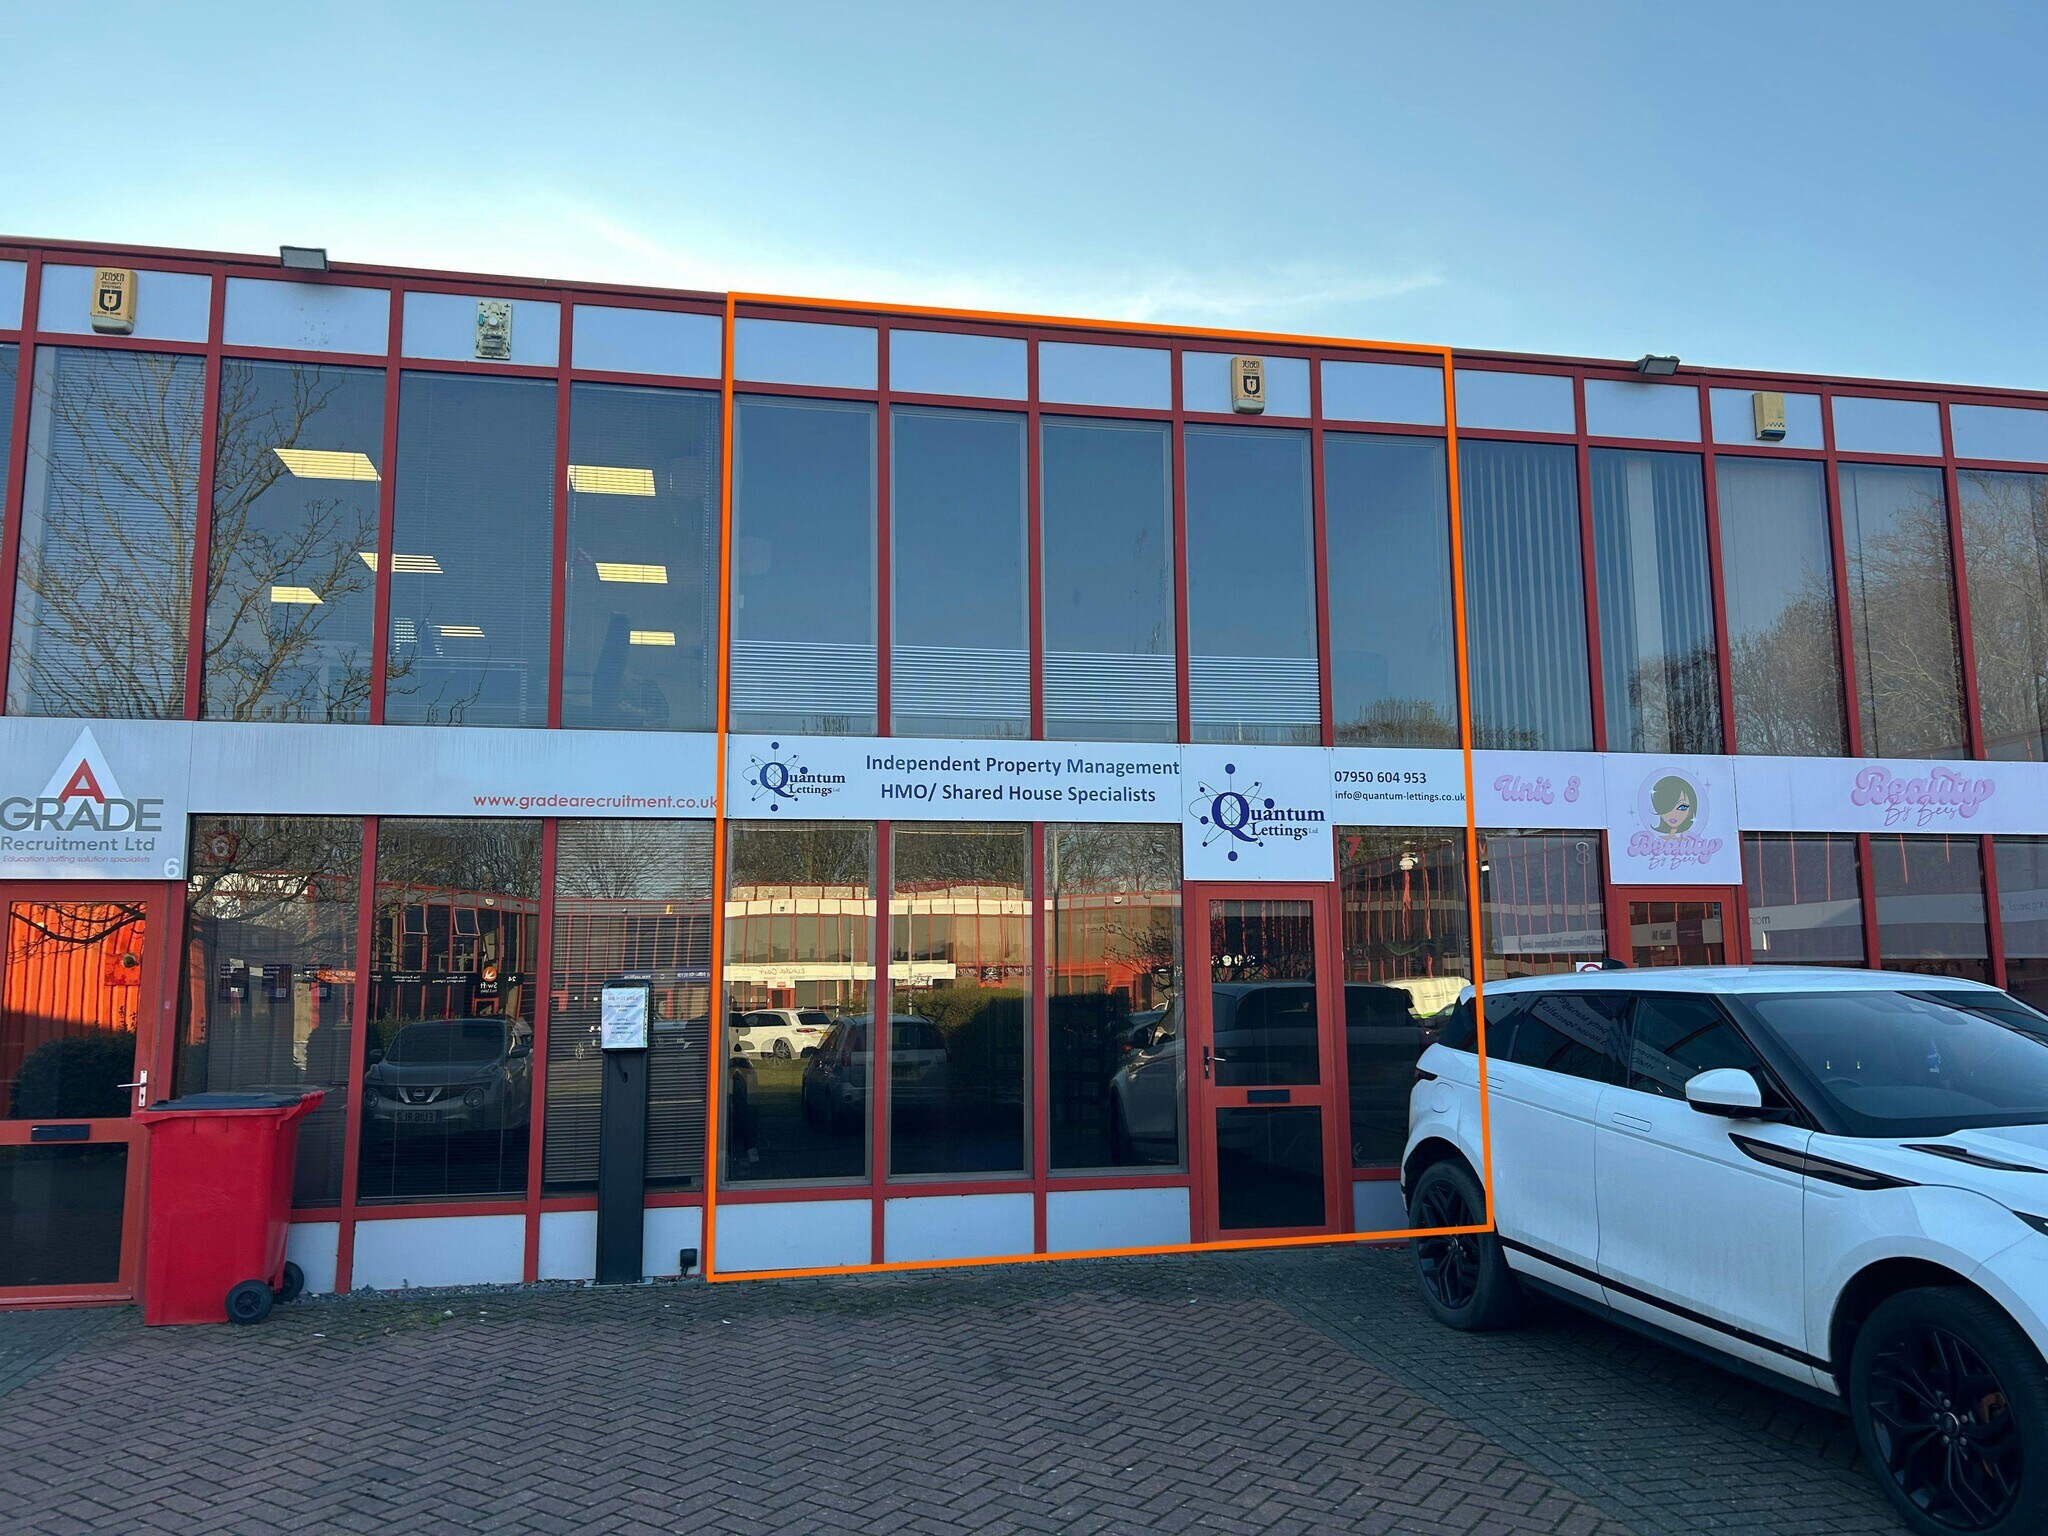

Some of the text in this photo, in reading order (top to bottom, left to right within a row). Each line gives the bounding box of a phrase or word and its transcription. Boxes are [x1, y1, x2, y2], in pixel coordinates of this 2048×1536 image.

[100, 271, 125, 282] JENSEN
[866, 754, 1180, 778] Independent Property Management
[760, 762, 846, 798] Quantum
[1334, 770, 1427, 784] 07950 604 953
[789, 783, 832, 797] Lettings
[881, 782, 1156, 804] HMO/ Shared House Specialists
[1335, 790, 1466, 803] info@quantum-lettings.co.uk
[1494, 774, 1581, 805] Unit 8
[1851, 765, 1996, 819] Beauty
[473, 794, 718, 809] www.gradearecruitment.co.uk
[0, 796, 164, 832] GRADE
[1211, 791, 1326, 842] Quantum
[1251, 822, 1308, 841] Lettings
[1, 835, 155, 851] Recruitment Ltd
[1626, 830, 1723, 865] Beauty
[3, 855, 151, 865] Education staffing solution specialists
[163, 857, 180, 878] 6
